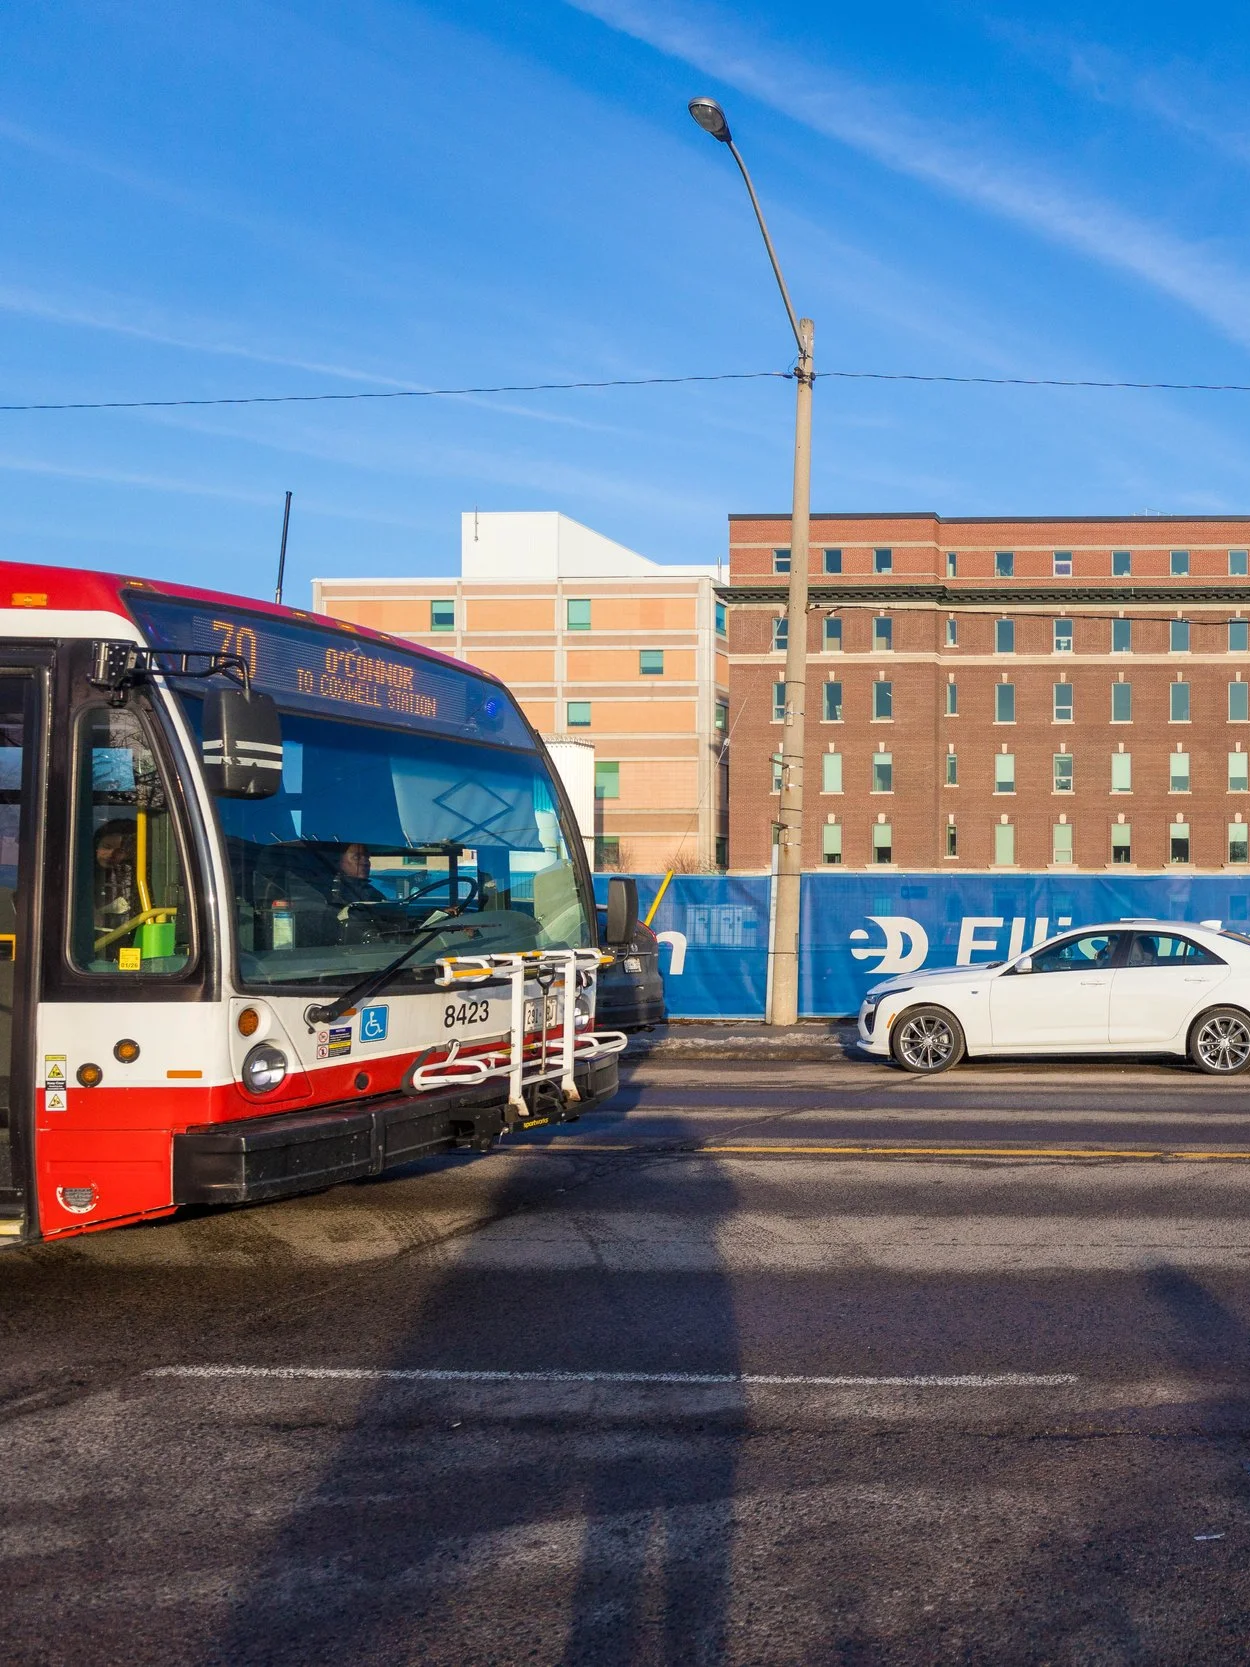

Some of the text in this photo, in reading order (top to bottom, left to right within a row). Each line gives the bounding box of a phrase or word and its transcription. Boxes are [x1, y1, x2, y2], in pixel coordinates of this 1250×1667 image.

[213, 620, 257, 680] 70
[325, 648, 415, 691] O'CONNOR
[297, 669, 313, 693] TO
[387, 689, 436, 717] STATION
[444, 1000, 489, 1028] 8423
